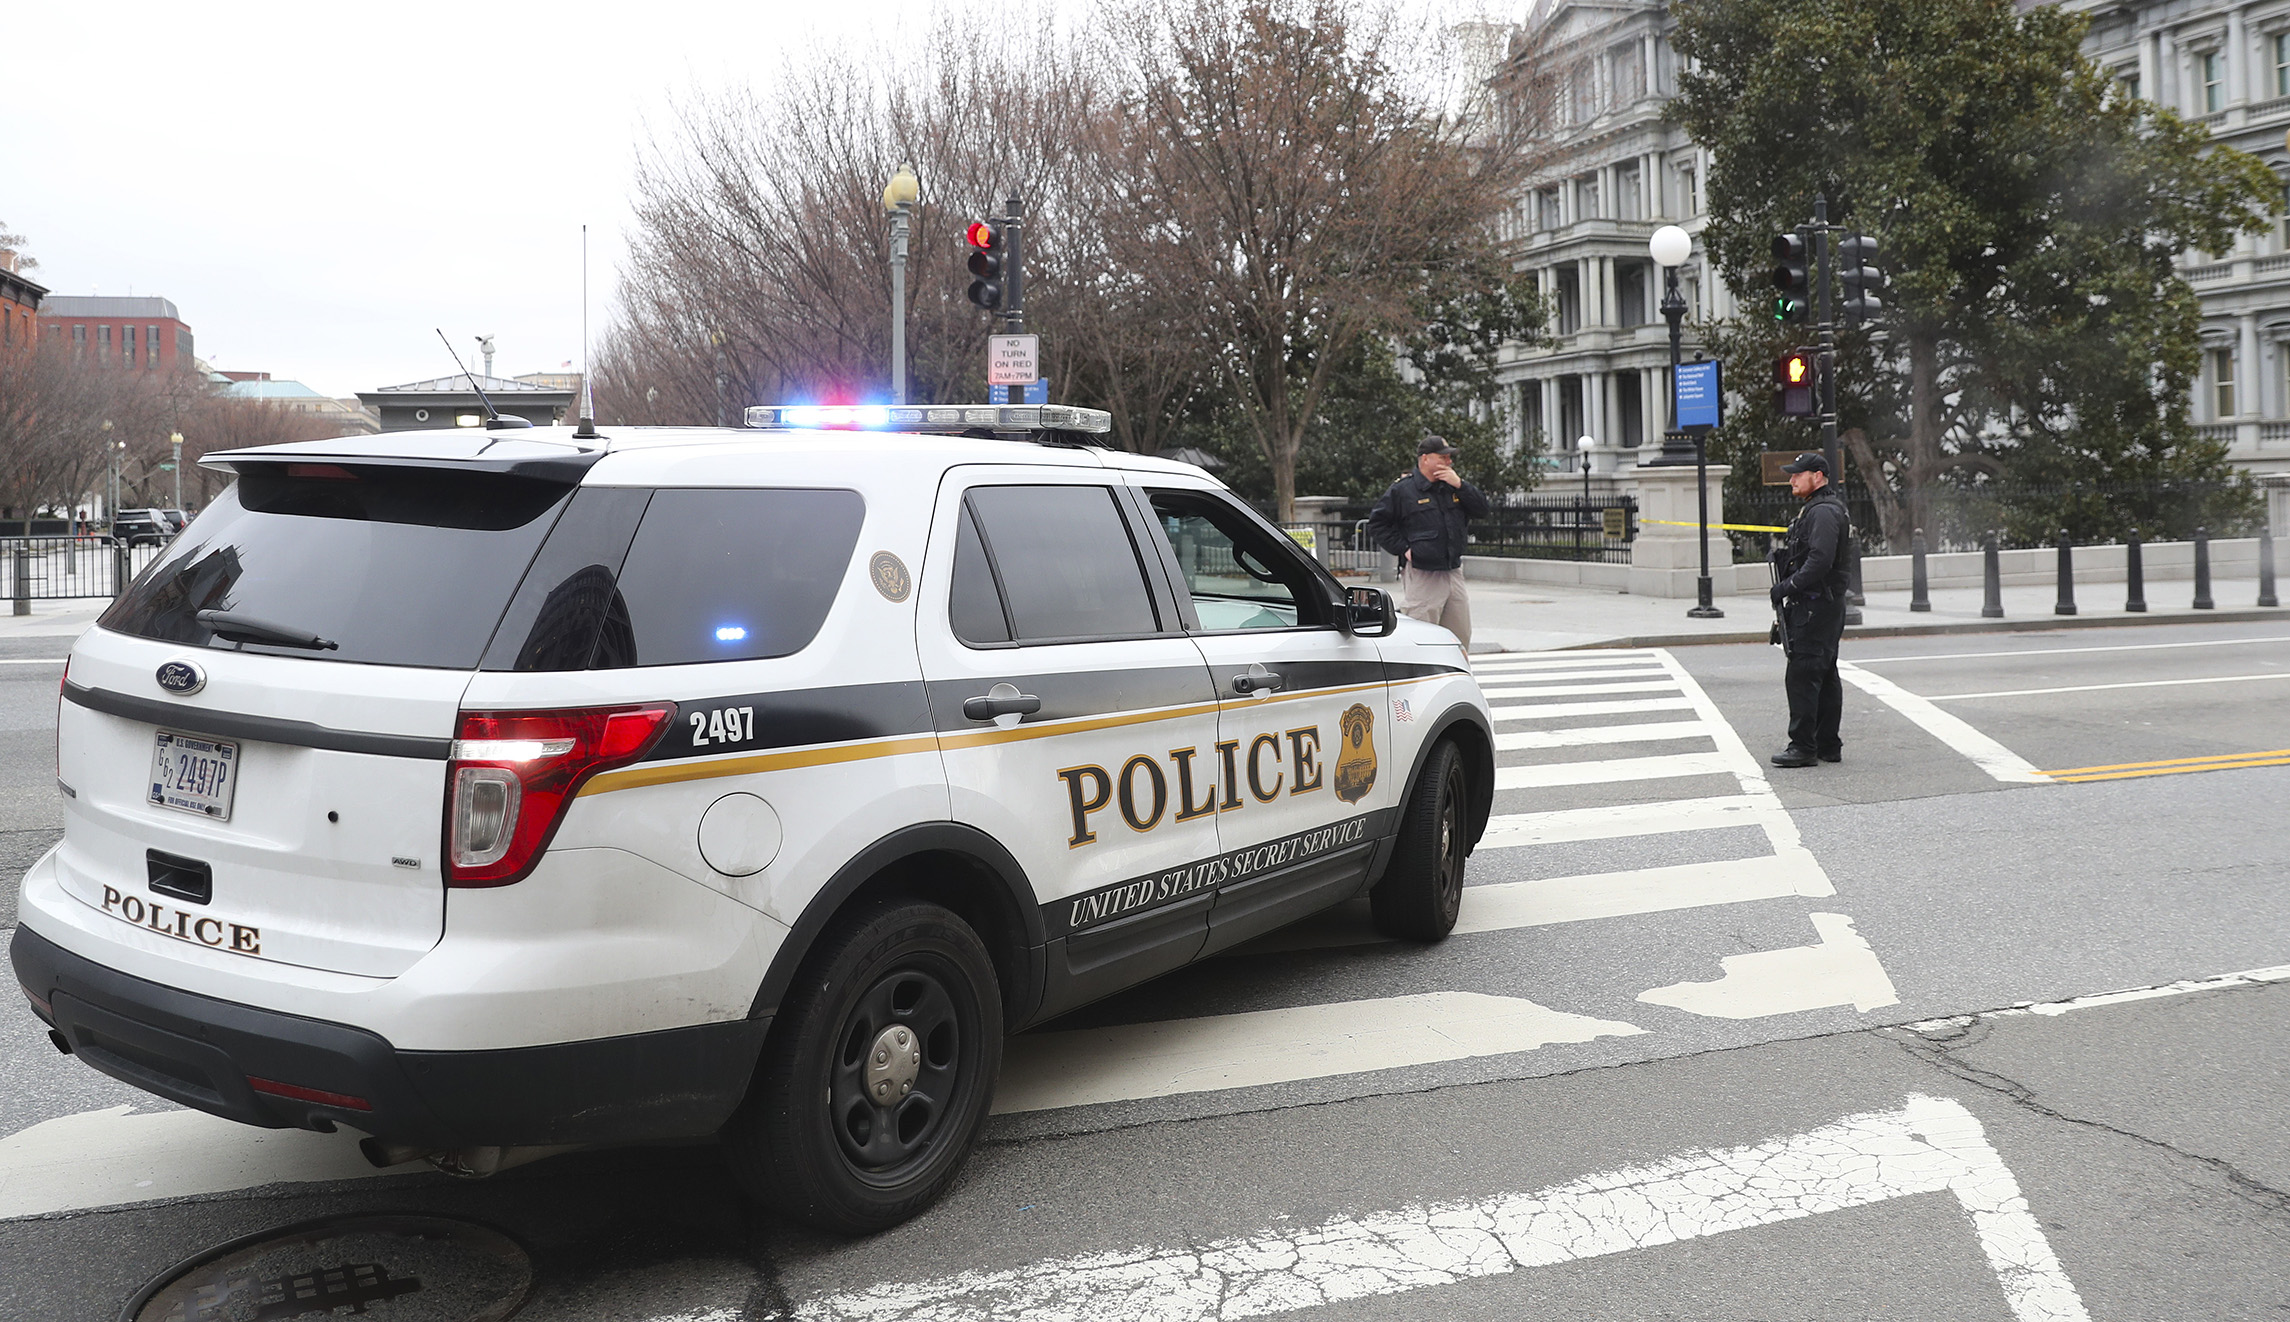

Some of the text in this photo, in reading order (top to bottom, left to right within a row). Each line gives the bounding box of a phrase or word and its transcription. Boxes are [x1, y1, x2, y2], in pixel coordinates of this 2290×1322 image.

[1001, 350, 1027, 358] TURN
[1007, 339, 1020, 347] NO
[161, 664, 191, 687] Ford
[689, 706, 754, 747] 2497
[185, 739, 214, 753] GOVERNMENT
[176, 754, 227, 798] 2497P
[1056, 725, 1324, 850] POLICE
[393, 857, 417, 867] AWD
[1069, 817, 1367, 927] UNITED STATES SECRET SERVICE
[101, 884, 261, 955] POLICE
